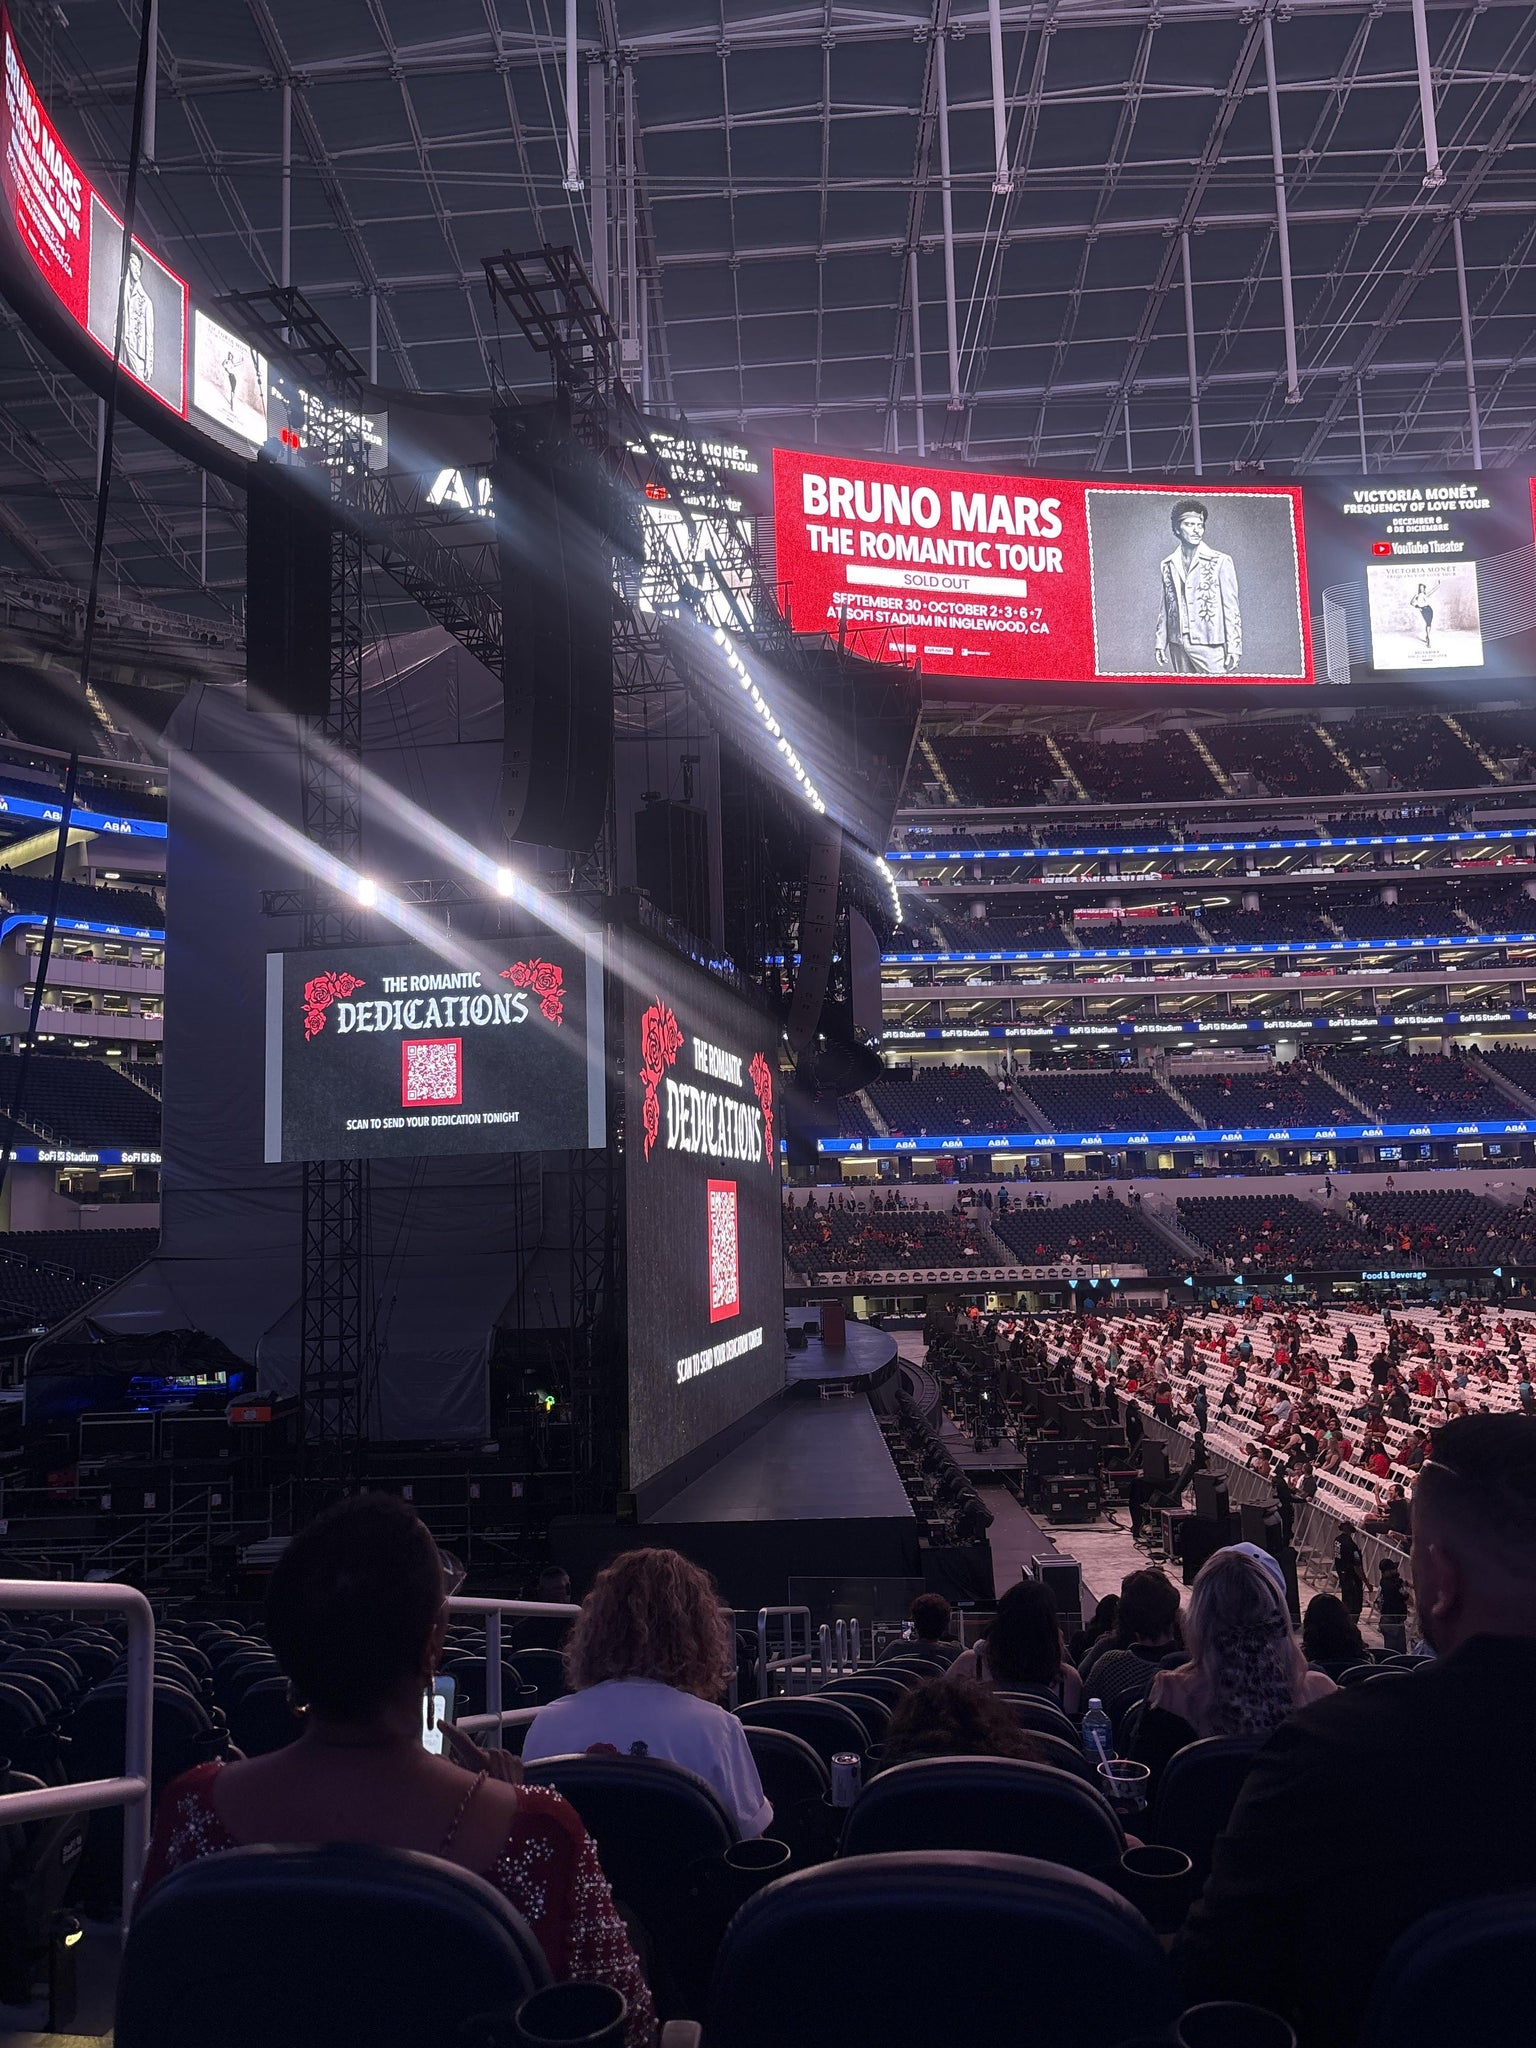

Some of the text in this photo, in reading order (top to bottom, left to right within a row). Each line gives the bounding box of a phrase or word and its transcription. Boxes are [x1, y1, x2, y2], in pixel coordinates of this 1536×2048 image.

[42, 125, 82, 212] MARS
[55, 186, 80, 240] TOUR
[730, 460, 758, 473] TOUR
[1353, 484, 1478, 503] VICTORIA MONÉT
[803, 473, 1062, 539] BRUNO MARS
[1344, 500, 1490, 514] FREQUENCY OF LOVE TOUR
[1392, 518, 1434, 526] DECEMBER
[1406, 524, 1449, 532] DICIEMBRE
[806, 524, 1064, 573] THE ROMANTIC TOUR
[1392, 541, 1464, 554] YouTube Theater
[904, 574, 970, 590] SOLD OUT
[832, 592, 903, 610] SEPTEMBER
[905, 598, 921, 611] 30
[846, 608, 874, 622] SOFI
[876, 611, 932, 627] STADIUM
[934, 616, 947, 628] IN
[949, 618, 1029, 634] INGLEWOOD,
[1030, 622, 1050, 635] CA
[43, 810, 131, 833] AB ABM
[383, 972, 481, 993] THE ROMANTIC
[337, 992, 529, 1034] DEDICATIONS
[900, 1030, 926, 1038] Stadium
[962, 1029, 989, 1037] Stadium
[1026, 1028, 1053, 1036] Stadium
[1090, 1026, 1117, 1034] Stadium
[1156, 1024, 1182, 1032] Stadium
[1220, 1022, 1247, 1030] Stadium
[1286, 1020, 1312, 1028] Stadium
[1351, 1018, 1378, 1026] Stadium
[1416, 1016, 1443, 1024] Stadium
[1482, 1014, 1510, 1022] Stadium
[693, 1037, 742, 1087] THE ROMANTIC
[346, 1112, 520, 1130] SCAN TO SEND YOUR DEDICATION TONIGHT
[666, 1077, 762, 1162] DEDICATIONS
[896, 1140, 917, 1150] ABM
[943, 1138, 963, 1148] ABM
[988, 1137, 1009, 1147] ABM
[1035, 1136, 1056, 1146] ABM
[1081, 1135, 1102, 1145] ABM
[1128, 1134, 1149, 1144] ABM
[1175, 1133, 1195, 1142] ABM
[1221, 1132, 1242, 1141] ABM
[1268, 1130, 1289, 1140] ABM
[1315, 1129, 1336, 1138] ABM
[1362, 1127, 1383, 1136] ABM
[1409, 1125, 1430, 1135] ABM
[1457, 1123, 1478, 1133] ABM
[1505, 1122, 1527, 1132] ABM
[38, 1150, 56, 1162] SoFi
[66, 1152, 98, 1162] Stadium
[122, 1152, 140, 1162] SoFi
[1362, 1271, 1427, 1280] Food & Beverage
[677, 1357, 692, 1384] SCAN
[692, 1353, 700, 1377] TO
[700, 1348, 712, 1374] SEND
